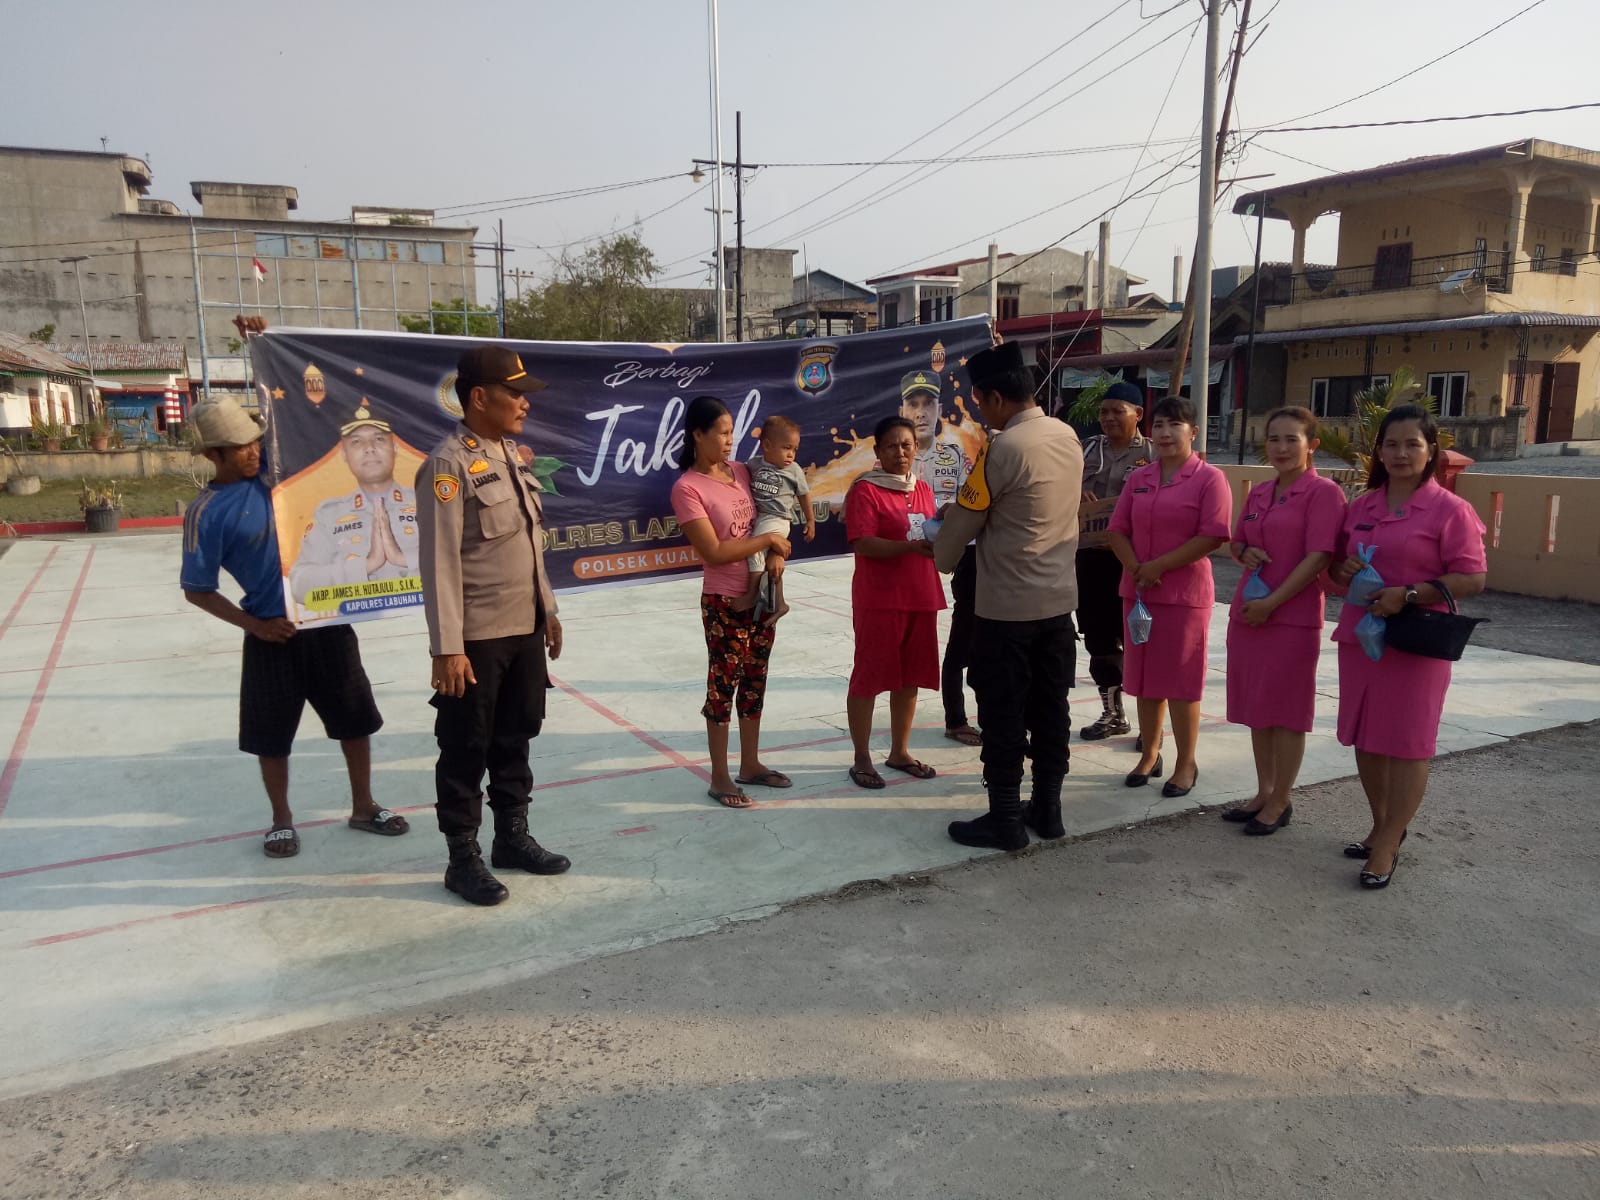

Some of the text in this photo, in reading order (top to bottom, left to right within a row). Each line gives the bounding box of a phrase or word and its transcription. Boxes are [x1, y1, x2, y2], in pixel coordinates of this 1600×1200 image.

[603, 361, 714, 388] Berbagi
[935, 468, 958, 476] POLRI
[332, 521, 363, 534] JAMES
[581, 549, 699, 574] POLSEK KUAL
[312, 589, 330, 602] AKBP.
[332, 586, 353, 599] JAMES
[355, 585, 361, 597] H.
[346, 599, 384, 612] KAPOLRES
[385, 595, 417, 607] LABUHAN
